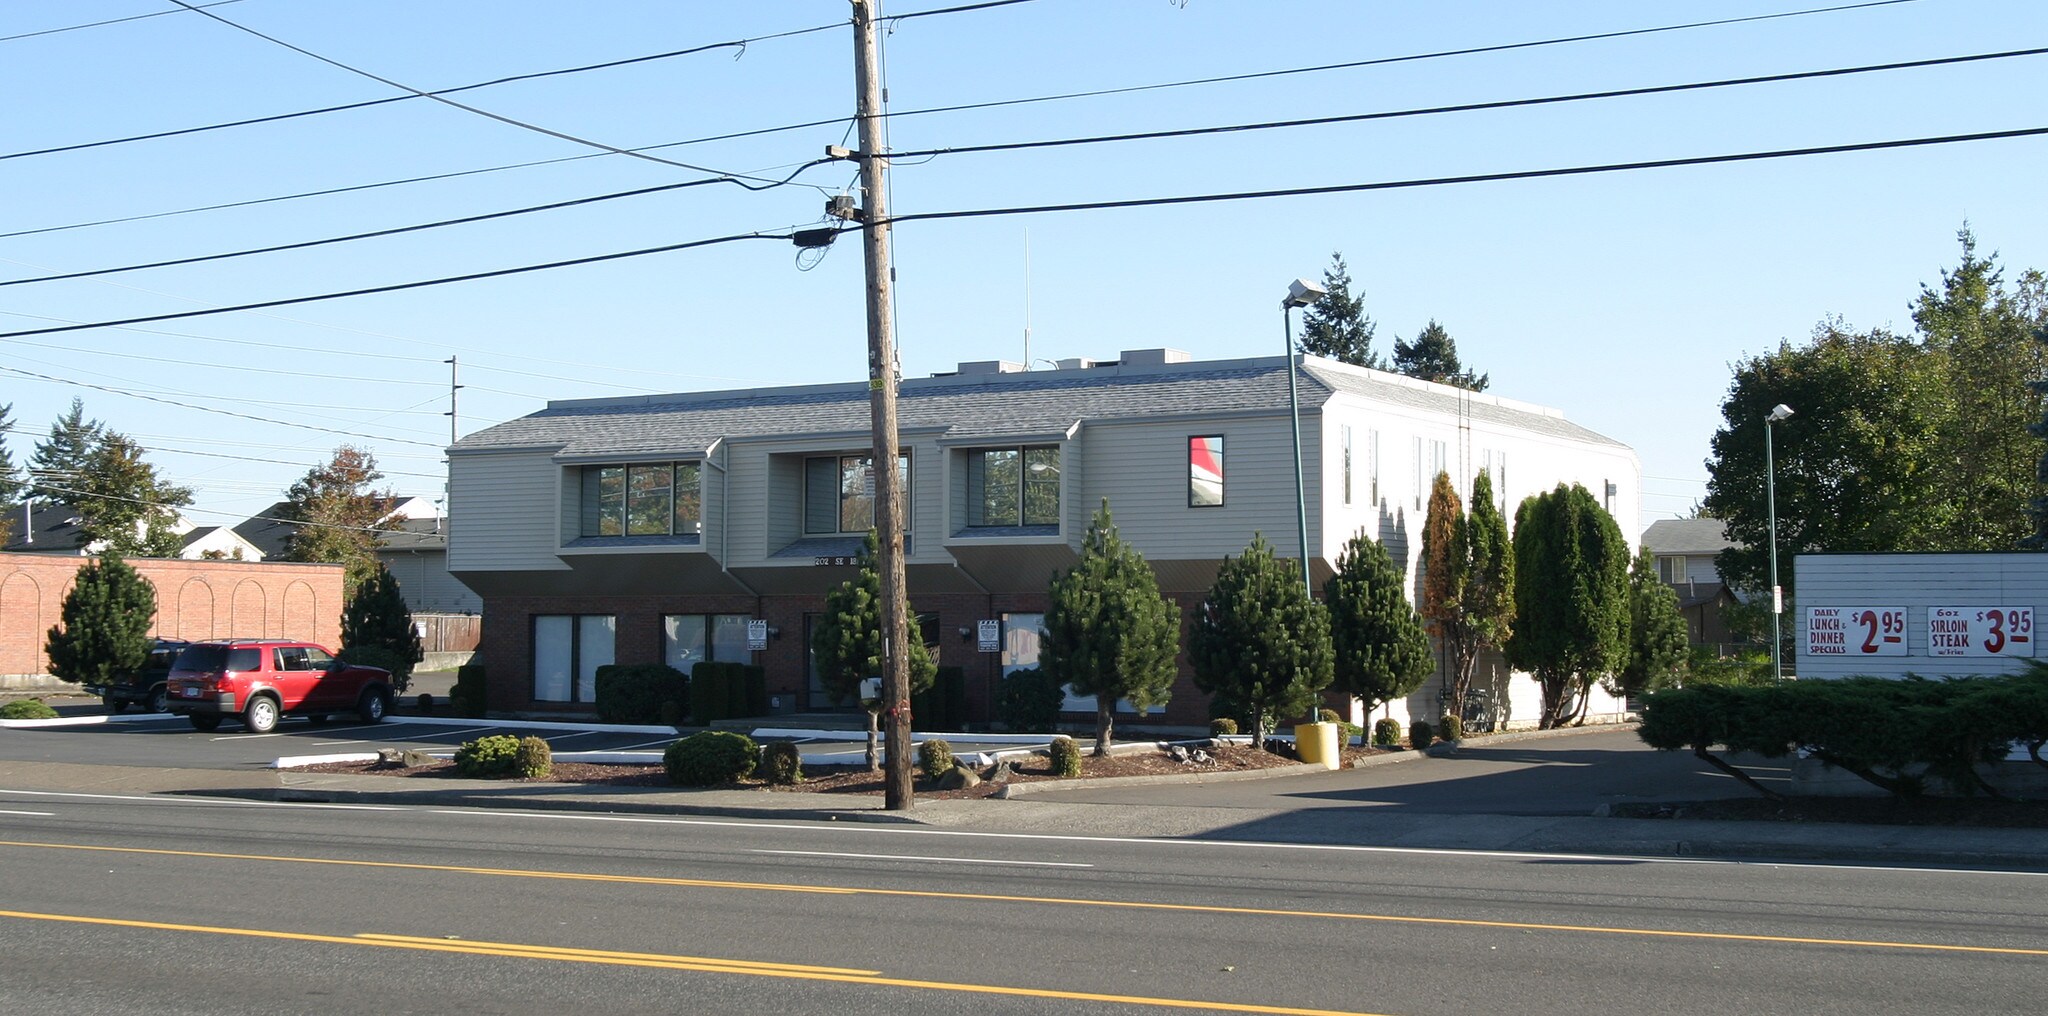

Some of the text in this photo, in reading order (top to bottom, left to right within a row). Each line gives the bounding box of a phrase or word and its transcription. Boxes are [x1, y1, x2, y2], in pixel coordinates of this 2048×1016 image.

[815, 557, 829, 566] 202
[835, 557, 844, 566] SE
[1810, 618, 1839, 630] LUNCH
[1931, 620, 1968, 633] SIRLOIN
[1810, 632, 1845, 644] DINNER
[1932, 634, 1970, 647] STEAK
[1810, 646, 1846, 654] SPECIALS
